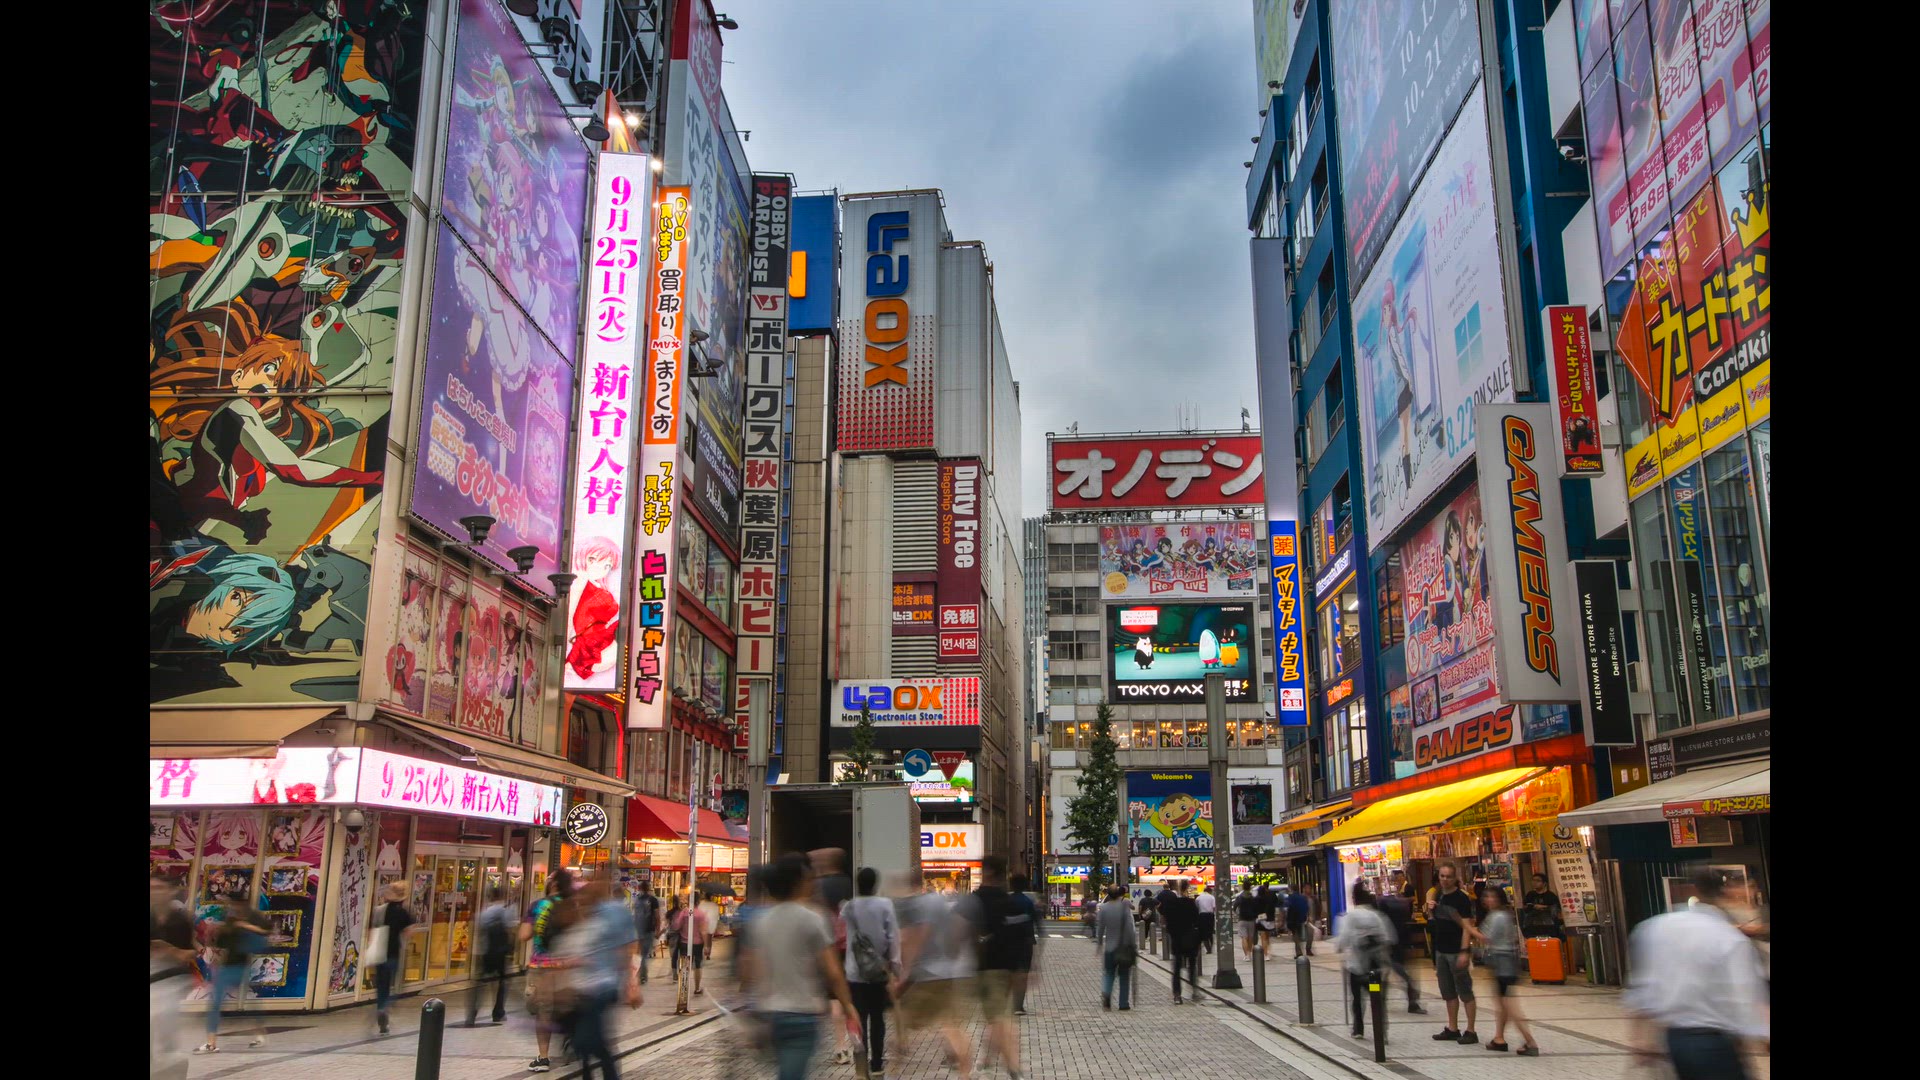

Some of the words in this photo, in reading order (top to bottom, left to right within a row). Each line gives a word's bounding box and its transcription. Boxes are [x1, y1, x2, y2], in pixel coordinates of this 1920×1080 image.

[657, 203, 674, 263] 買います
[673, 197, 687, 242] DVD
[752, 180, 773, 284] PARADISE
[769, 181, 787, 250] HOBBY
[594, 175, 640, 343] 9月25日(火)
[657, 268, 682, 330] 買取り
[1486, 358, 1510, 404] SALE
[1562, 323, 1585, 414] カードキングダム
[652, 359, 676, 435] まっくす
[583, 361, 632, 516] 新台入替
[1445, 395, 1476, 460] 8.22
[940, 466, 953, 511] Flagship
[952, 465, 978, 516] Duty
[1056, 438, 1263, 499] オノデン
[642, 475, 660, 536] 買います
[656, 461, 674, 534] フィギュア
[942, 514, 953, 545] Store
[954, 519, 978, 569] Free
[1500, 414, 1563, 687] GAMERS
[943, 608, 976, 625] 免税
[1579, 593, 1593, 621] AKIBA
[942, 637, 976, 650] 면세점
[1582, 624, 1597, 654] STORE
[1117, 684, 1170, 696] TOKYO
[1173, 683, 1204, 696] MX
[1586, 656, 1603, 711] ALIENWARE
[841, 713, 865, 721] Hom
[869, 713, 917, 721] Electronics
[919, 712, 943, 721] Store
[1414, 704, 1515, 769] GAMERS
[1679, 739, 1713, 753] ALIENWARE
[1714, 736, 1734, 746] STORE
[1736, 732, 1756, 742] AKIBA
[459, 770, 520, 818] 新台入替
[1151, 773, 1182, 781] Welcome
[570, 805, 604, 820] SMOKER'S
[1150, 836, 1213, 850] IHABARA
